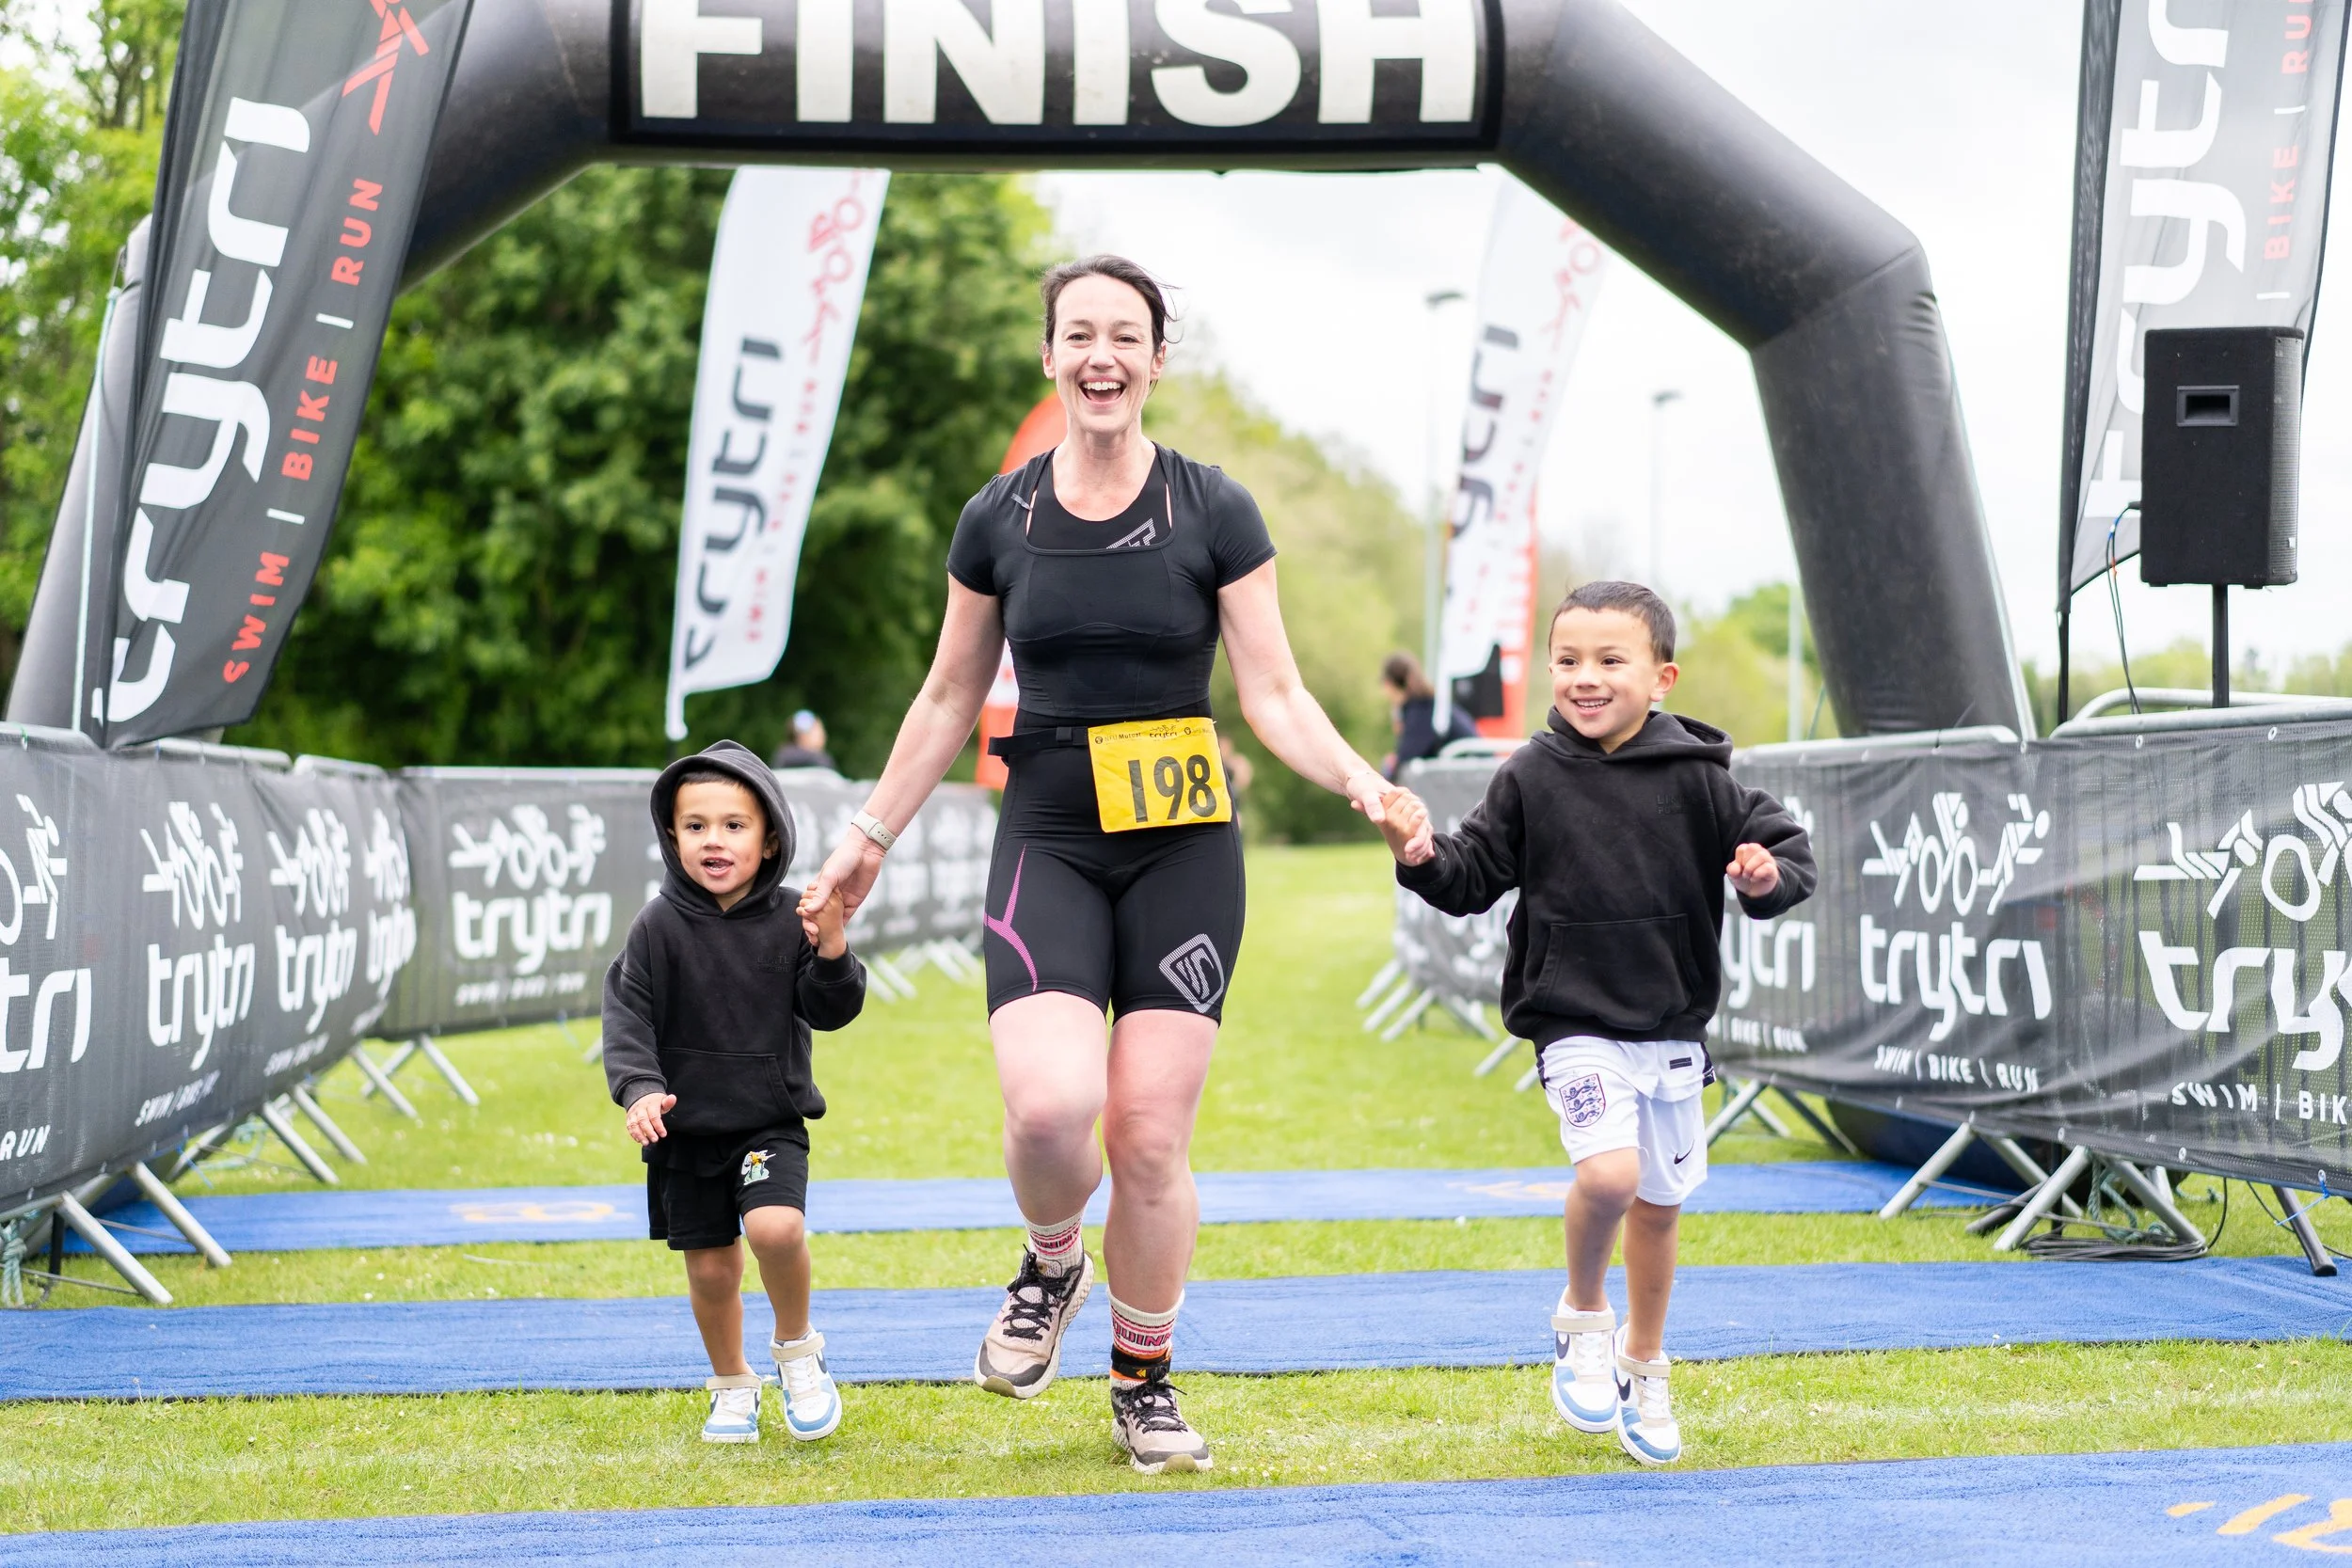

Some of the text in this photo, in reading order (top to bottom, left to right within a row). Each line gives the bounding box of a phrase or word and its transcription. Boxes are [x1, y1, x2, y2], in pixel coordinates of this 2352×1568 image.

[640, 0, 1478, 127] FINISH
[2264, 0, 2312, 261] BIKE RU
[223, 179, 383, 684] SWIM BIKE RUN
[1128, 754, 1216, 823] 198
[2137, 929, 2352, 1071] try
[1928, 1053, 1976, 1085] BIKE
[2171, 1082, 2352, 1126] SWIM BIK
